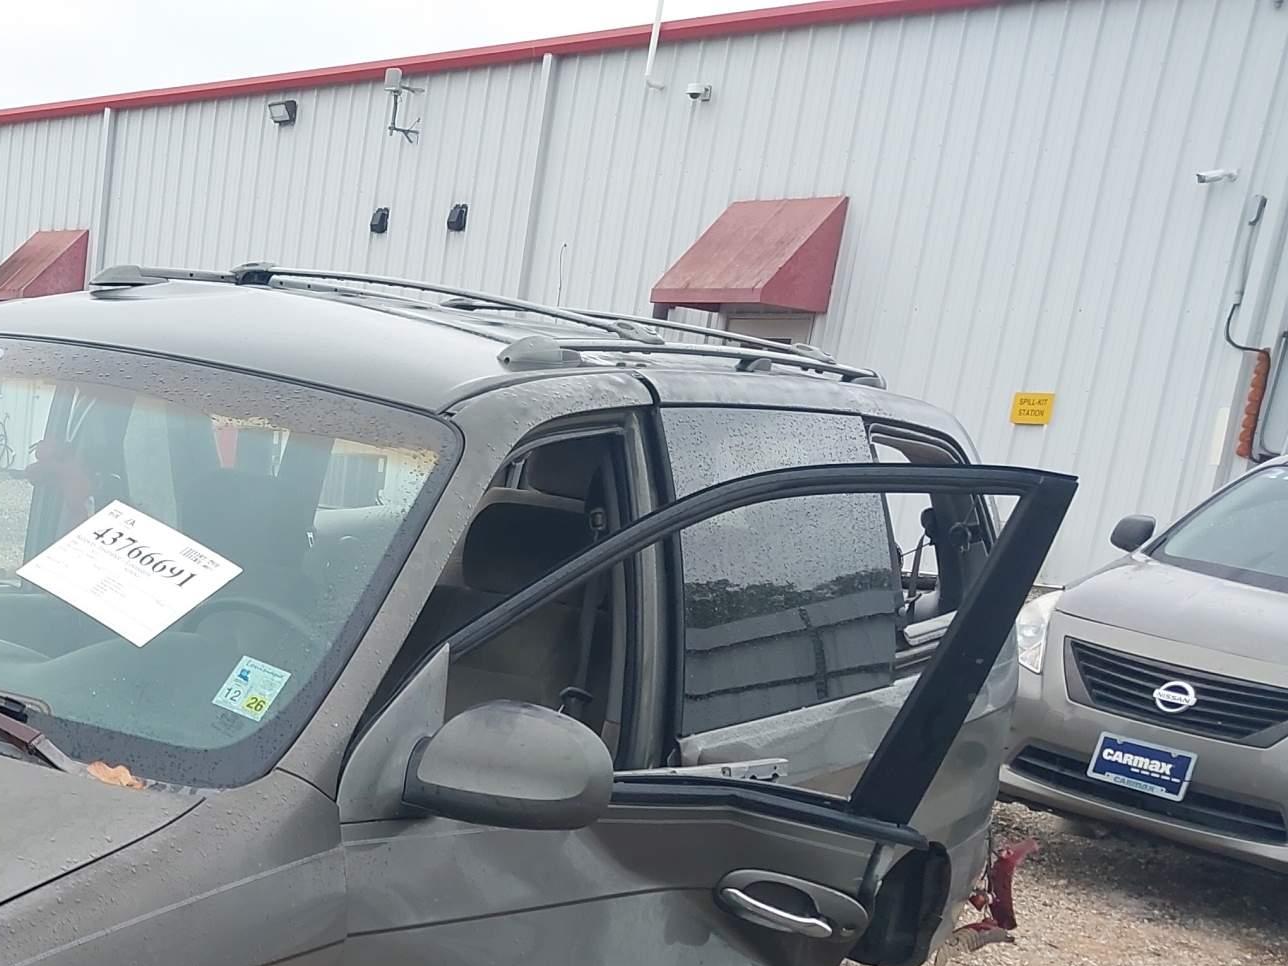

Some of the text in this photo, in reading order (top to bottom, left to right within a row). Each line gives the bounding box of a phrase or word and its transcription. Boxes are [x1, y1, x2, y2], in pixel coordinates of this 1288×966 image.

[1018, 408, 1045, 417] STATION
[91, 526, 198, 588] 43766691
[224, 687, 241, 702] 12
[1155, 691, 1190, 704] NISSAN
[246, 696, 266, 712] 26
